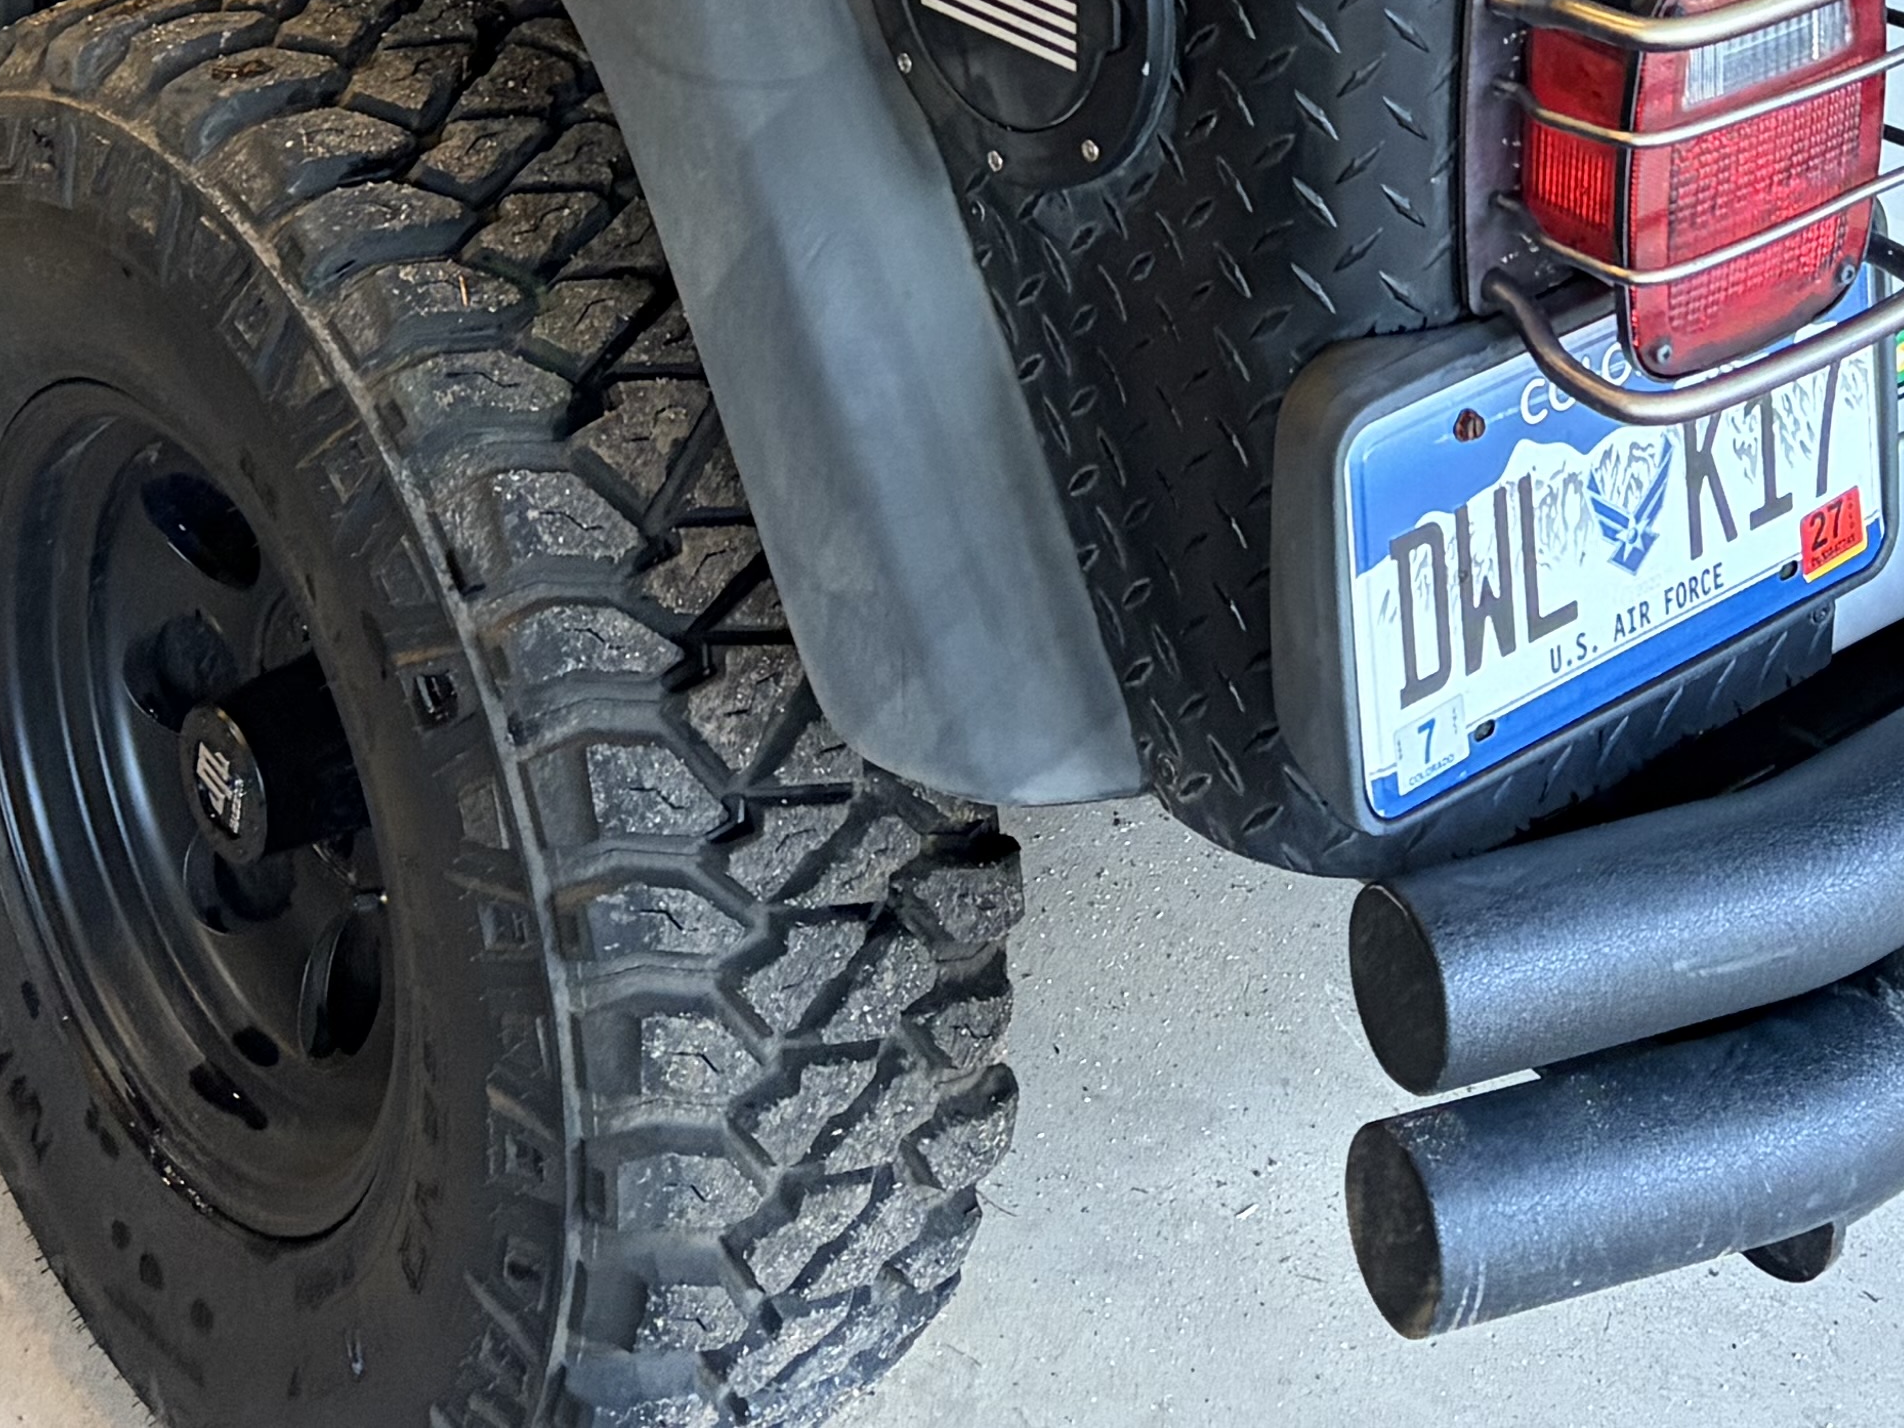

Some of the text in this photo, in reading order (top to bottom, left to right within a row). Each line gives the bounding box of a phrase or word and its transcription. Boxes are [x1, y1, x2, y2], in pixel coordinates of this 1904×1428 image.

[1389, 360, 1842, 710] DWL K17
[1809, 498, 1844, 552] 27
[1550, 562, 1725, 675] U.S. AIR FORCE
[1417, 717, 1436, 764] 7
